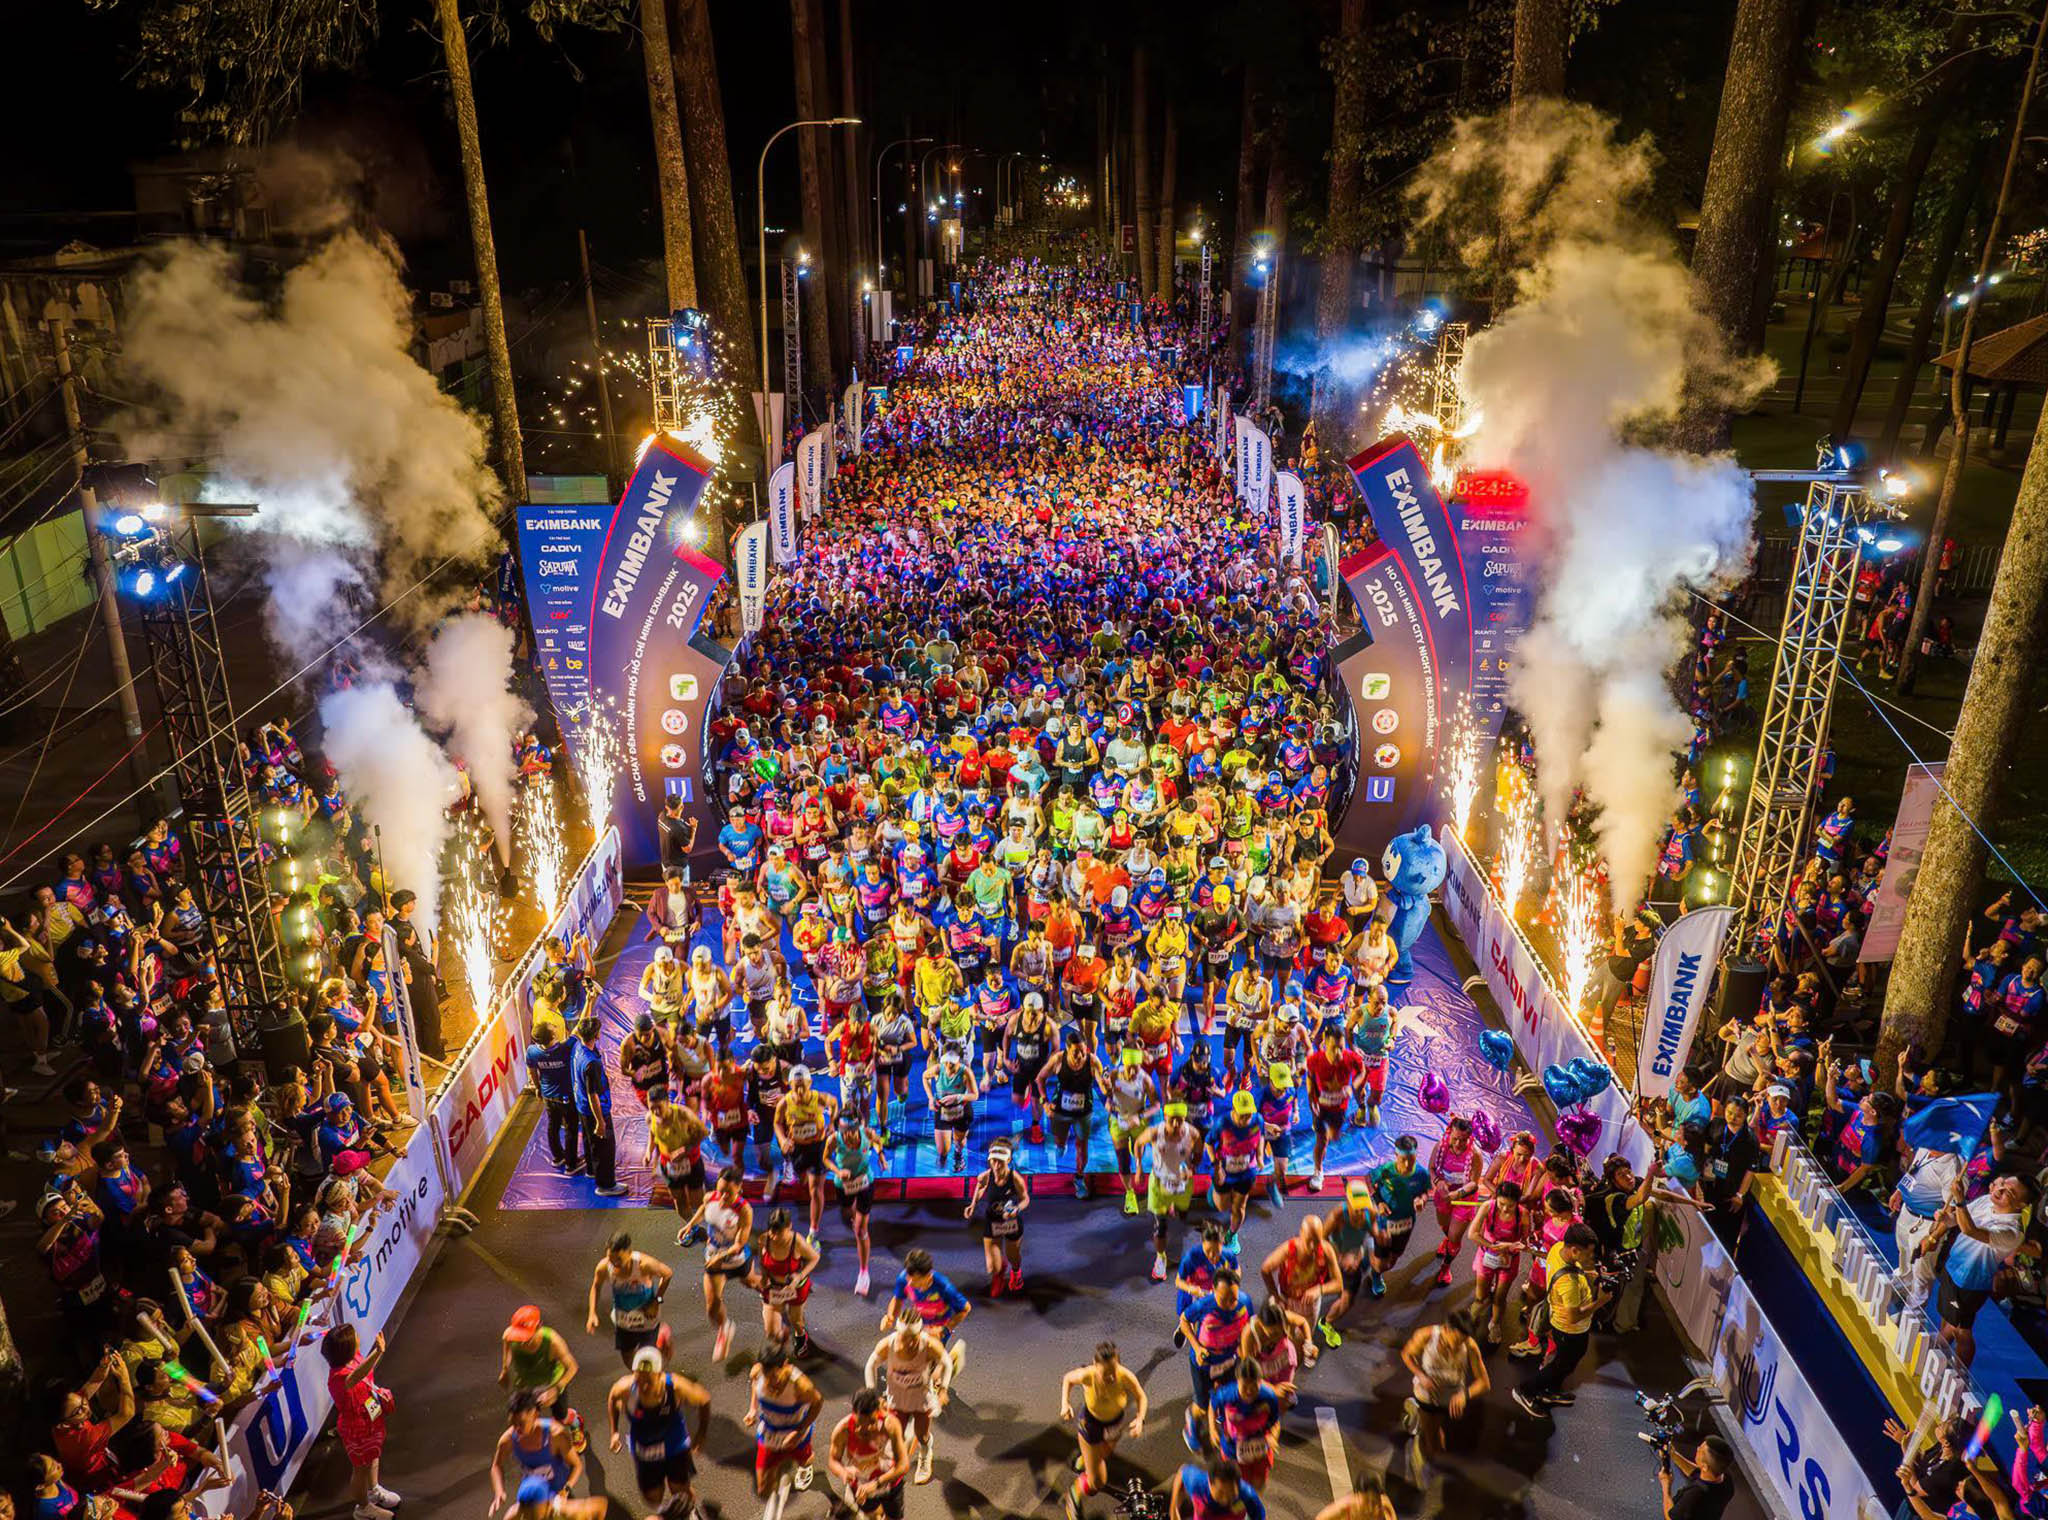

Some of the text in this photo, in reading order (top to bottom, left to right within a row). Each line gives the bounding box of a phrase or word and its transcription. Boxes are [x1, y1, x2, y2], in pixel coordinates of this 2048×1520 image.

[526, 519, 602, 530] EXIMBANK
[780, 487, 789, 548] EXIMBANK
[1461, 520, 1528, 531] EXIMBAN
[602, 469, 678, 619] EXIMBANK
[748, 538, 758, 589] EXIMBANK
[1385, 468, 1460, 619] EXIMBANK
[650, 568, 679, 616] EXIMBANK
[667, 580, 699, 629] 2025
[1365, 579, 1398, 627] 2025
[640, 615, 654, 641] MINH
[1384, 565, 1397, 580] HO
[1394, 581, 1407, 598] CHI
[1402, 598, 1417, 623] MINH
[1412, 624, 1425, 643] CITY
[1419, 645, 1431, 675] NIGHT
[635, 640, 646, 659] CHÍ
[627, 696, 637, 731] THÀNH
[1373, 780, 1389, 798] U
[1491, 937, 1538, 1036] CADIVI
[1652, 951, 1702, 1077] EXIMBANK
[448, 1035, 518, 1158] CADIVI
[377, 1175, 428, 1272] motive
